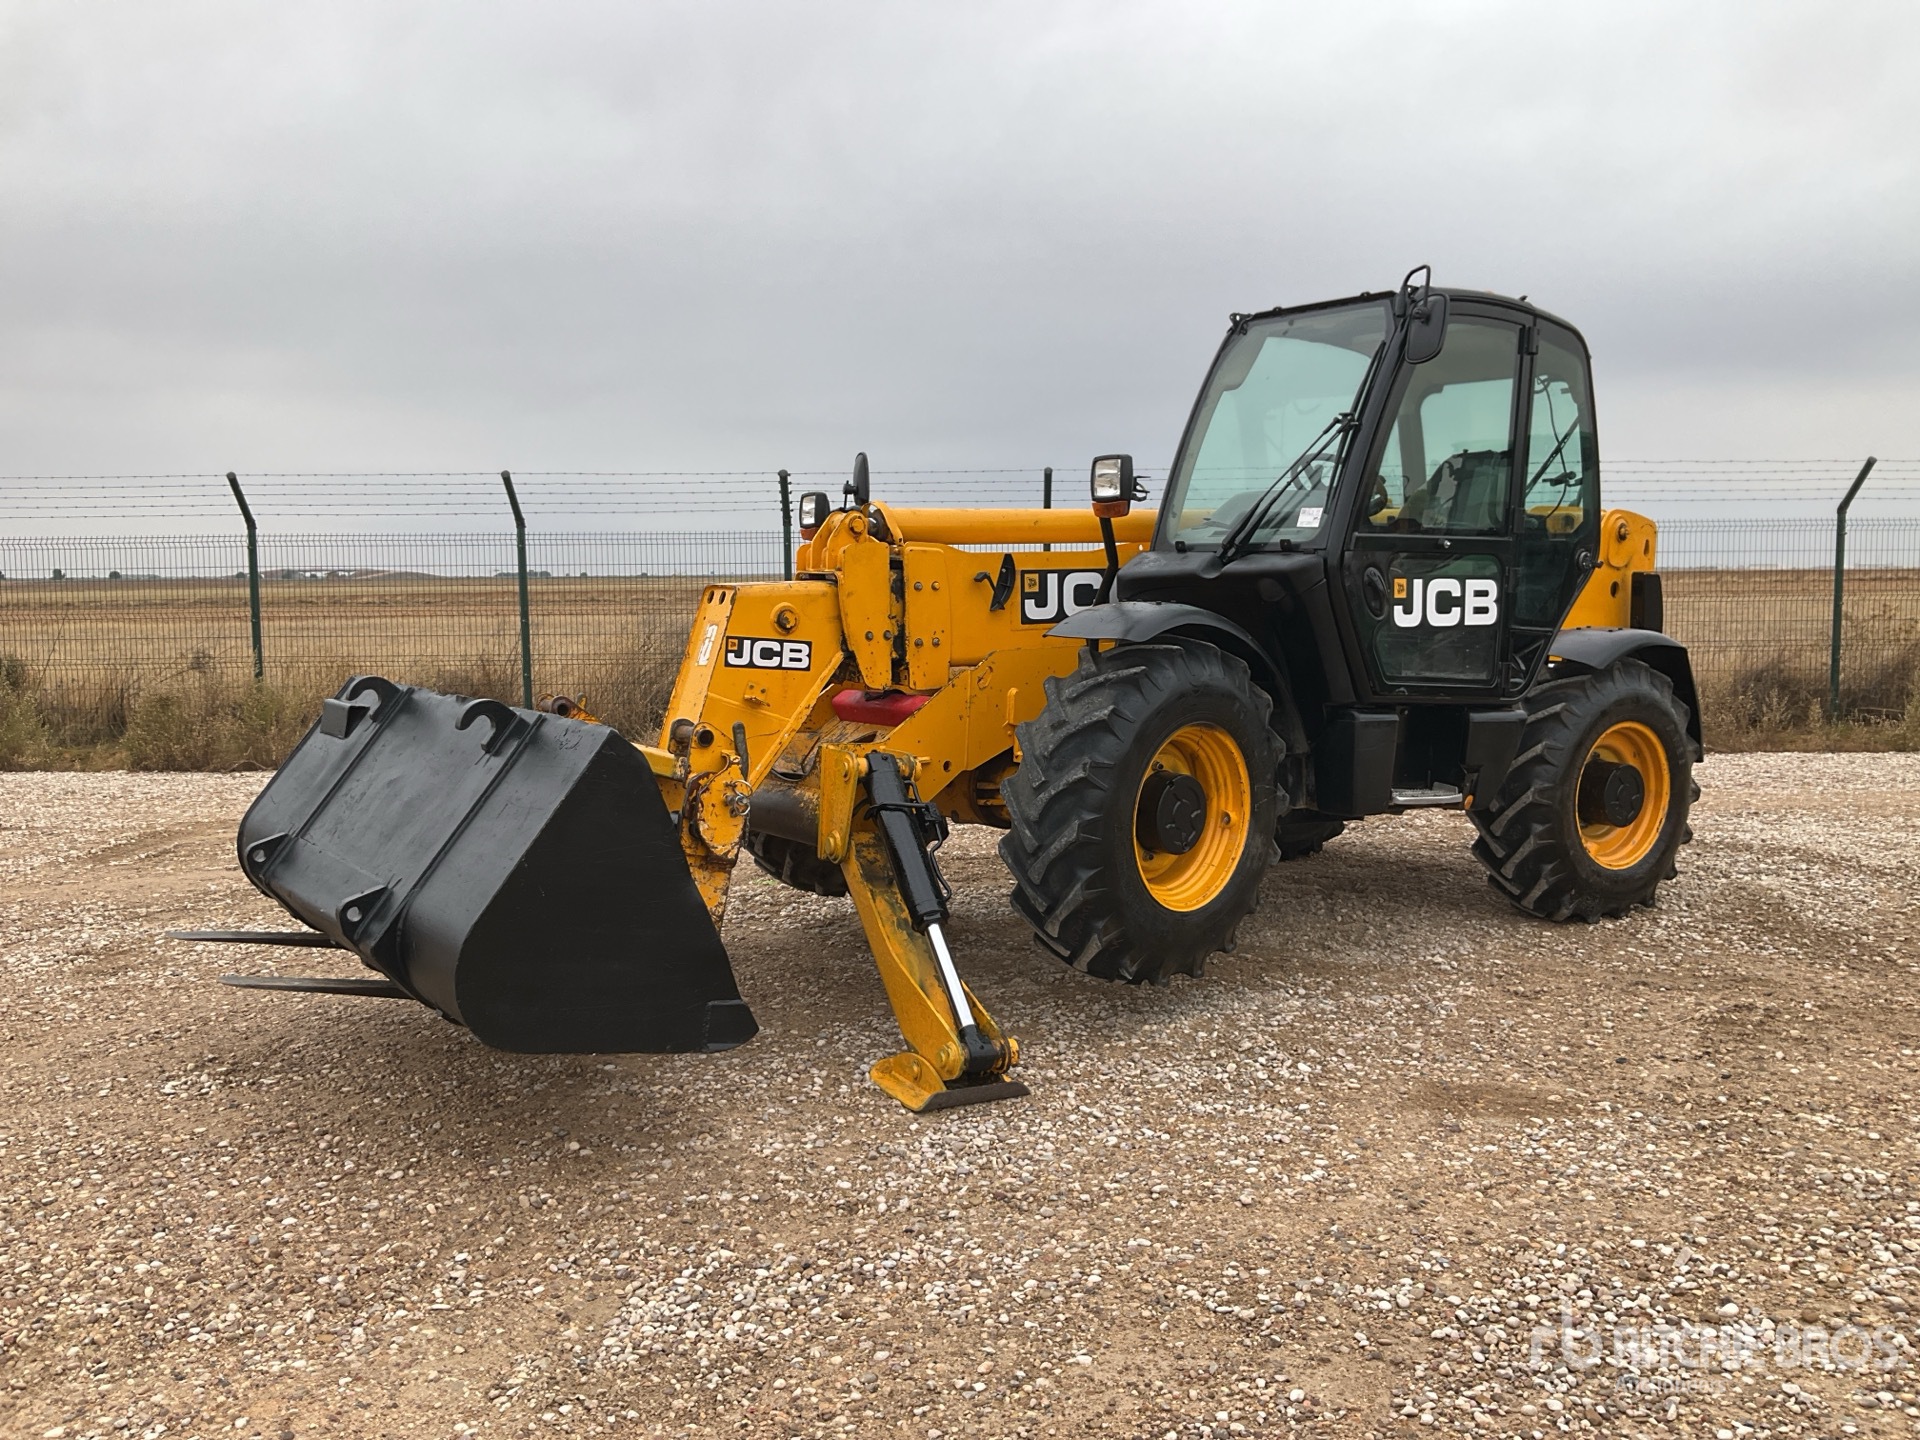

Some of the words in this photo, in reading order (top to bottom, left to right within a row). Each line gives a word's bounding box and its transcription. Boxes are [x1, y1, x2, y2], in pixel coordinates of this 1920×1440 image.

[1025, 572, 1119, 620] JC
[1394, 578, 1497, 628] JCB
[727, 640, 810, 669] JCB
